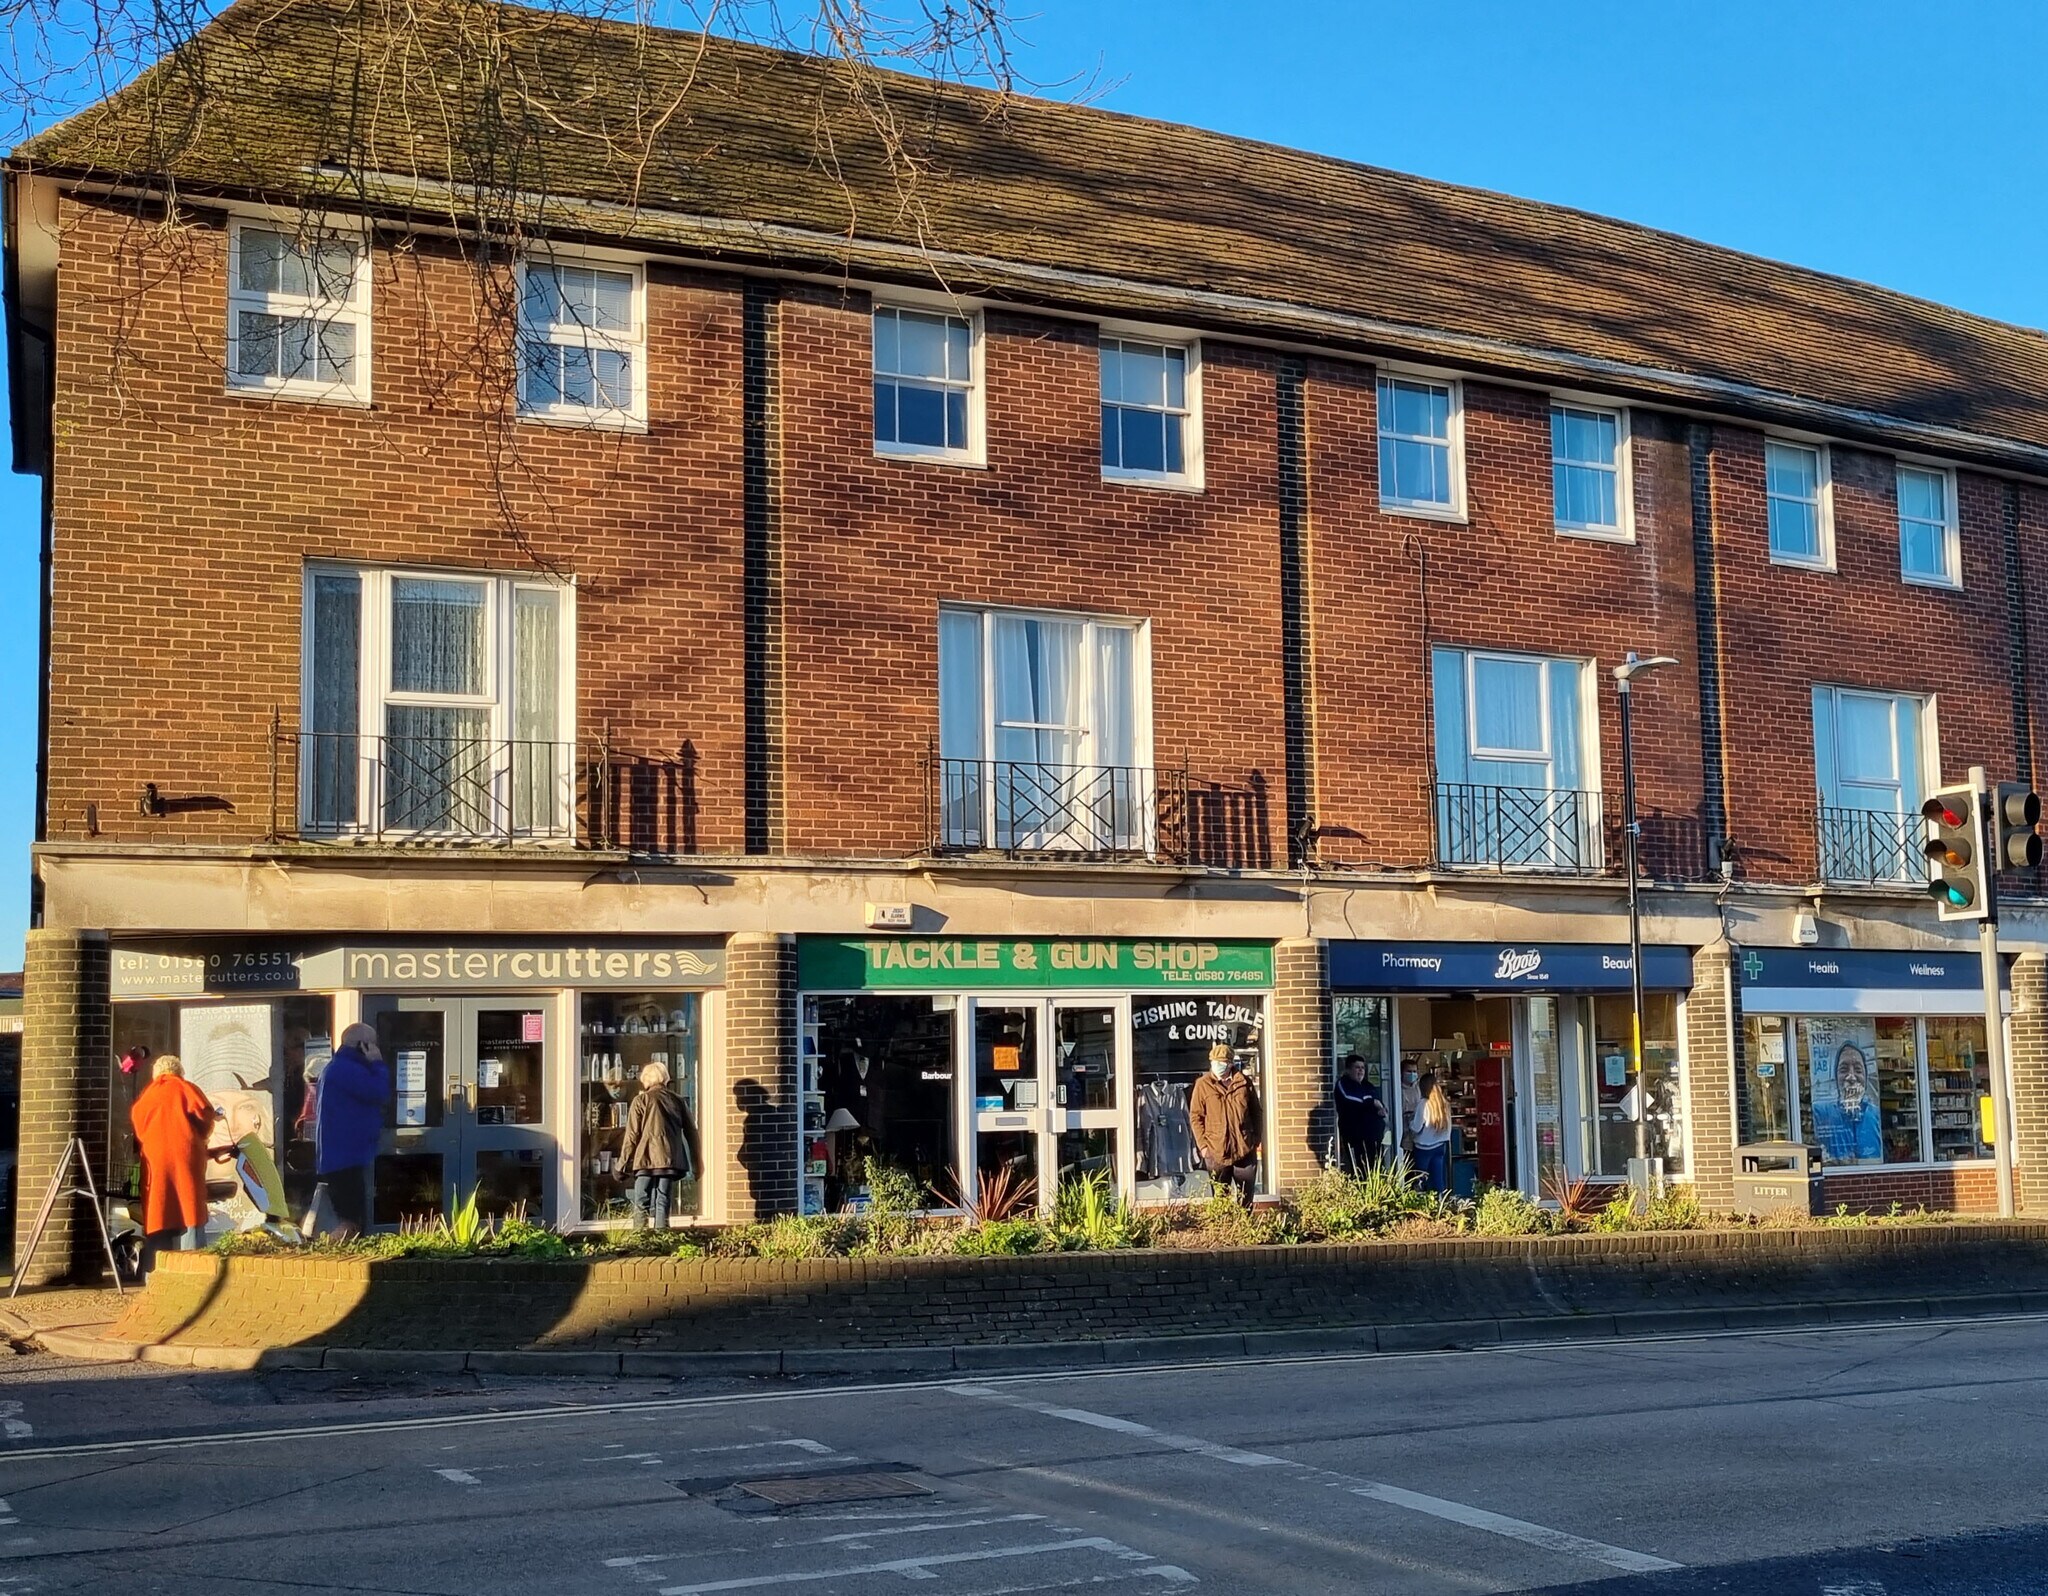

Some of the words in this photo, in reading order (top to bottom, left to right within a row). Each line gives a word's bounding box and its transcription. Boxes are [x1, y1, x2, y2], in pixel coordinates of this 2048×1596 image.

[119, 955, 149, 970] tel:
[158, 953, 221, 969] 01580
[865, 940, 1001, 969] TACKLE
[1012, 941, 1038, 970] &
[1050, 941, 1118, 970] GUN
[1133, 942, 1219, 970] SHOP
[1602, 955, 1633, 969] Beaut
[350, 947, 673, 979] mastercutters
[1382, 953, 1442, 972] Pharmacy
[1494, 948, 1541, 981] Boots
[1808, 960, 1839, 974] Health
[1909, 963, 1945, 976] Wellness
[1162, 970, 1193, 981] TELE:
[1194, 971, 1225, 981] 01580
[1227, 971, 1264, 981] 764851
[1132, 1001, 1198, 1029] FISHING
[1206, 1001, 1265, 1030] TACKLE
[1168, 1024, 1180, 1040] &
[1185, 1024, 1228, 1040] GUNS
[1812, 1032, 1833, 1045] NHS
[1813, 1046, 1829, 1059] FLU
[1814, 1060, 1828, 1075] JAB
[921, 1071, 953, 1080] Barbour
[1481, 1112, 1500, 1126] 50%
[1754, 1186, 1788, 1196] LITTER
